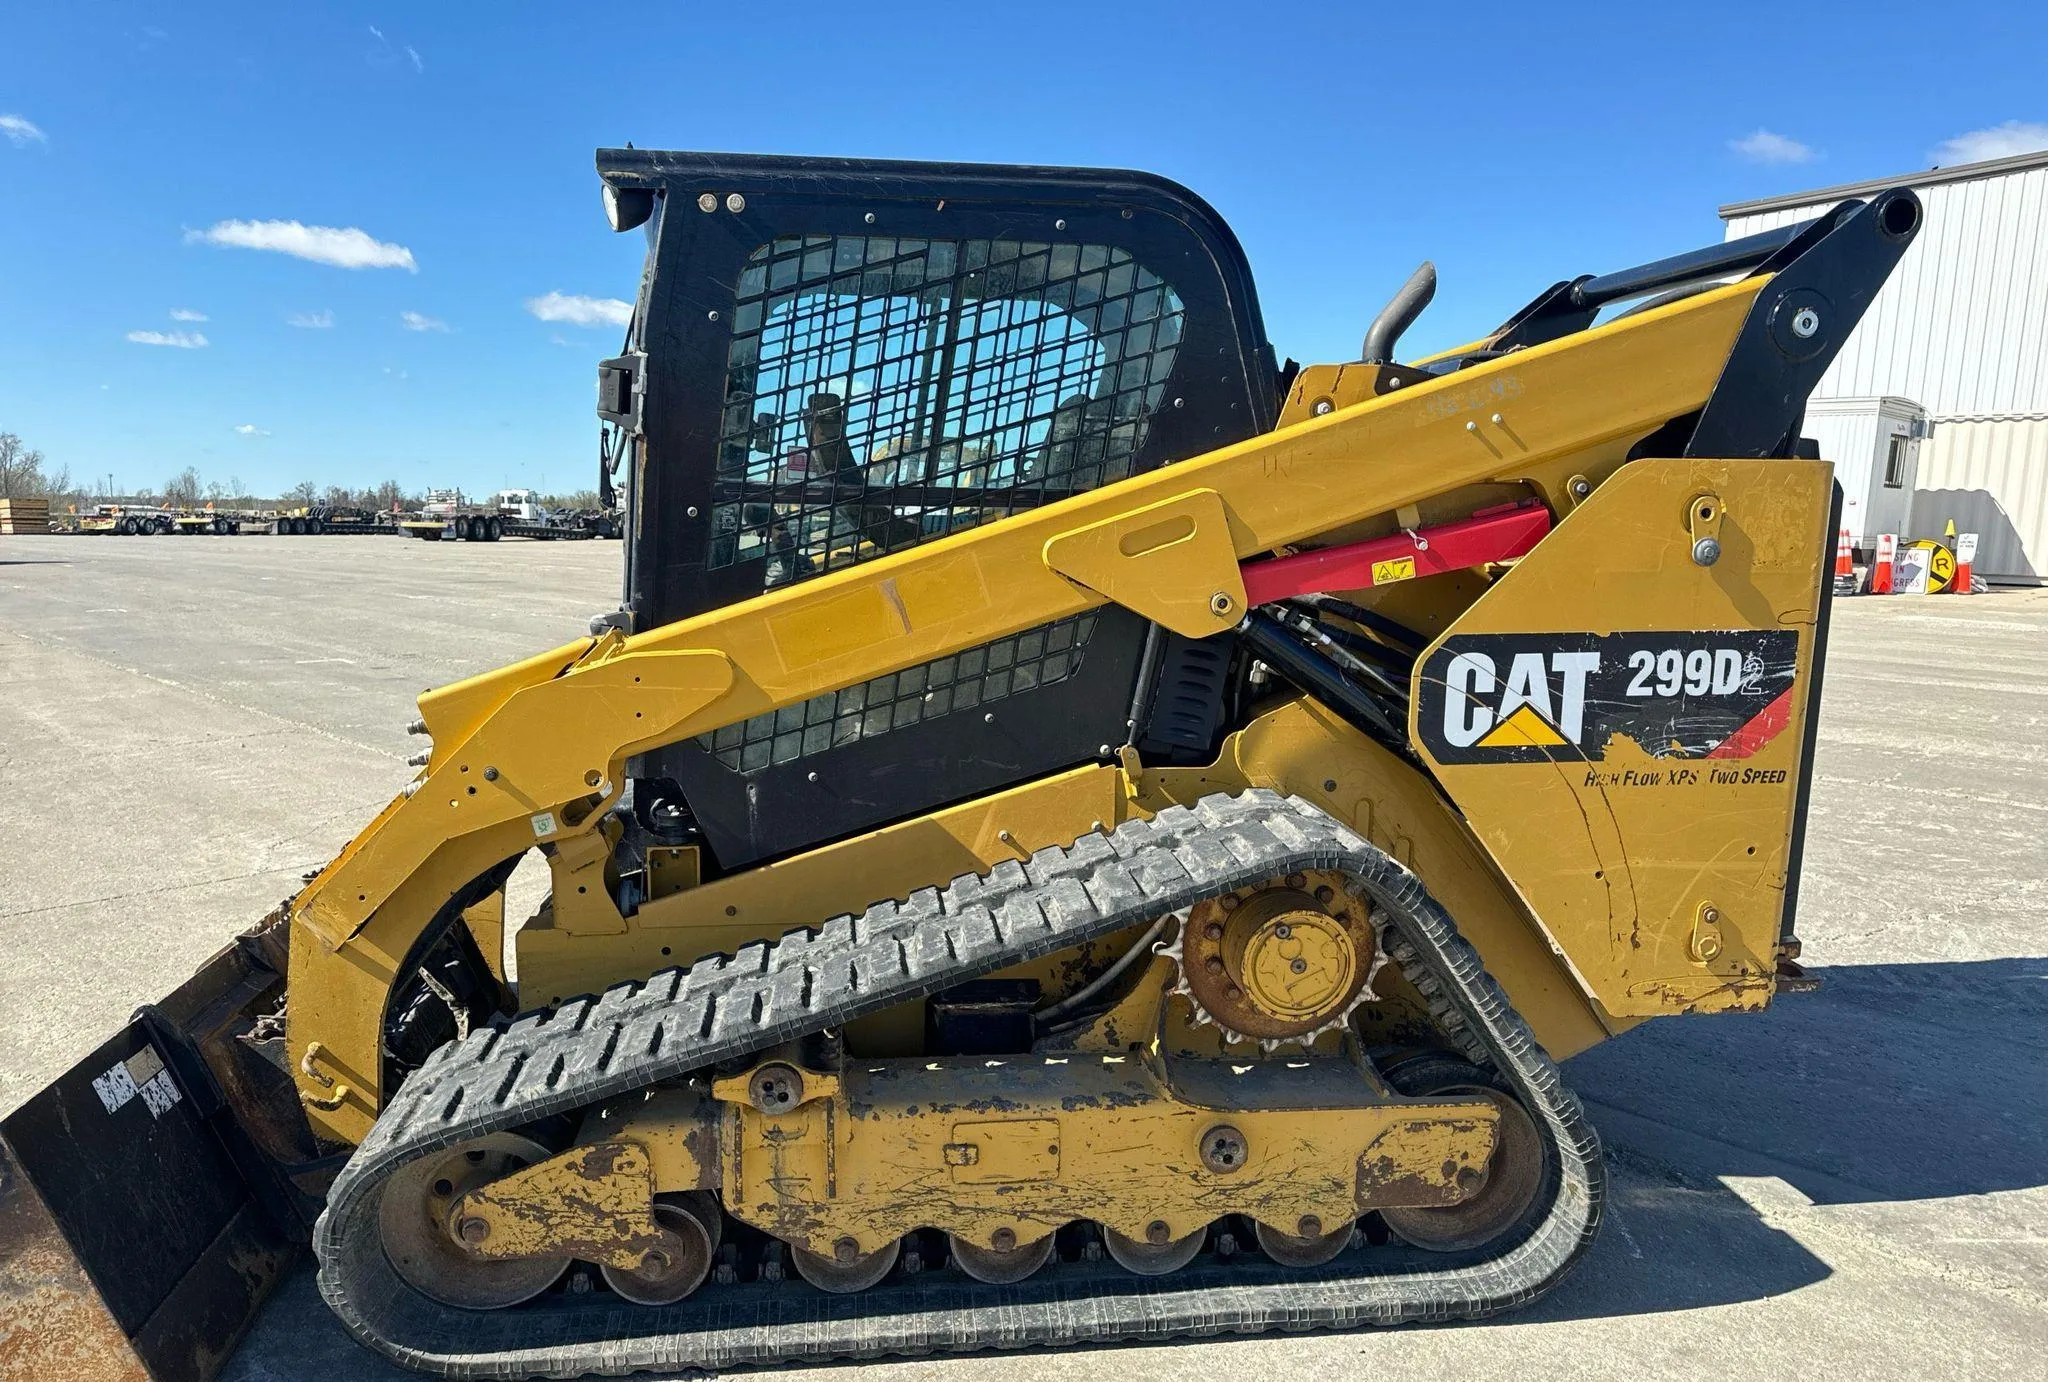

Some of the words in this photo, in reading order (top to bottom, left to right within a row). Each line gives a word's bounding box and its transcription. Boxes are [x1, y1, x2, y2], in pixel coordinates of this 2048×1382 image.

[1936, 558, 1949, 570] R
[1443, 652, 1601, 748] CAT
[1667, 769, 1699, 786] XPS
[1742, 768, 1787, 784] SPEED
